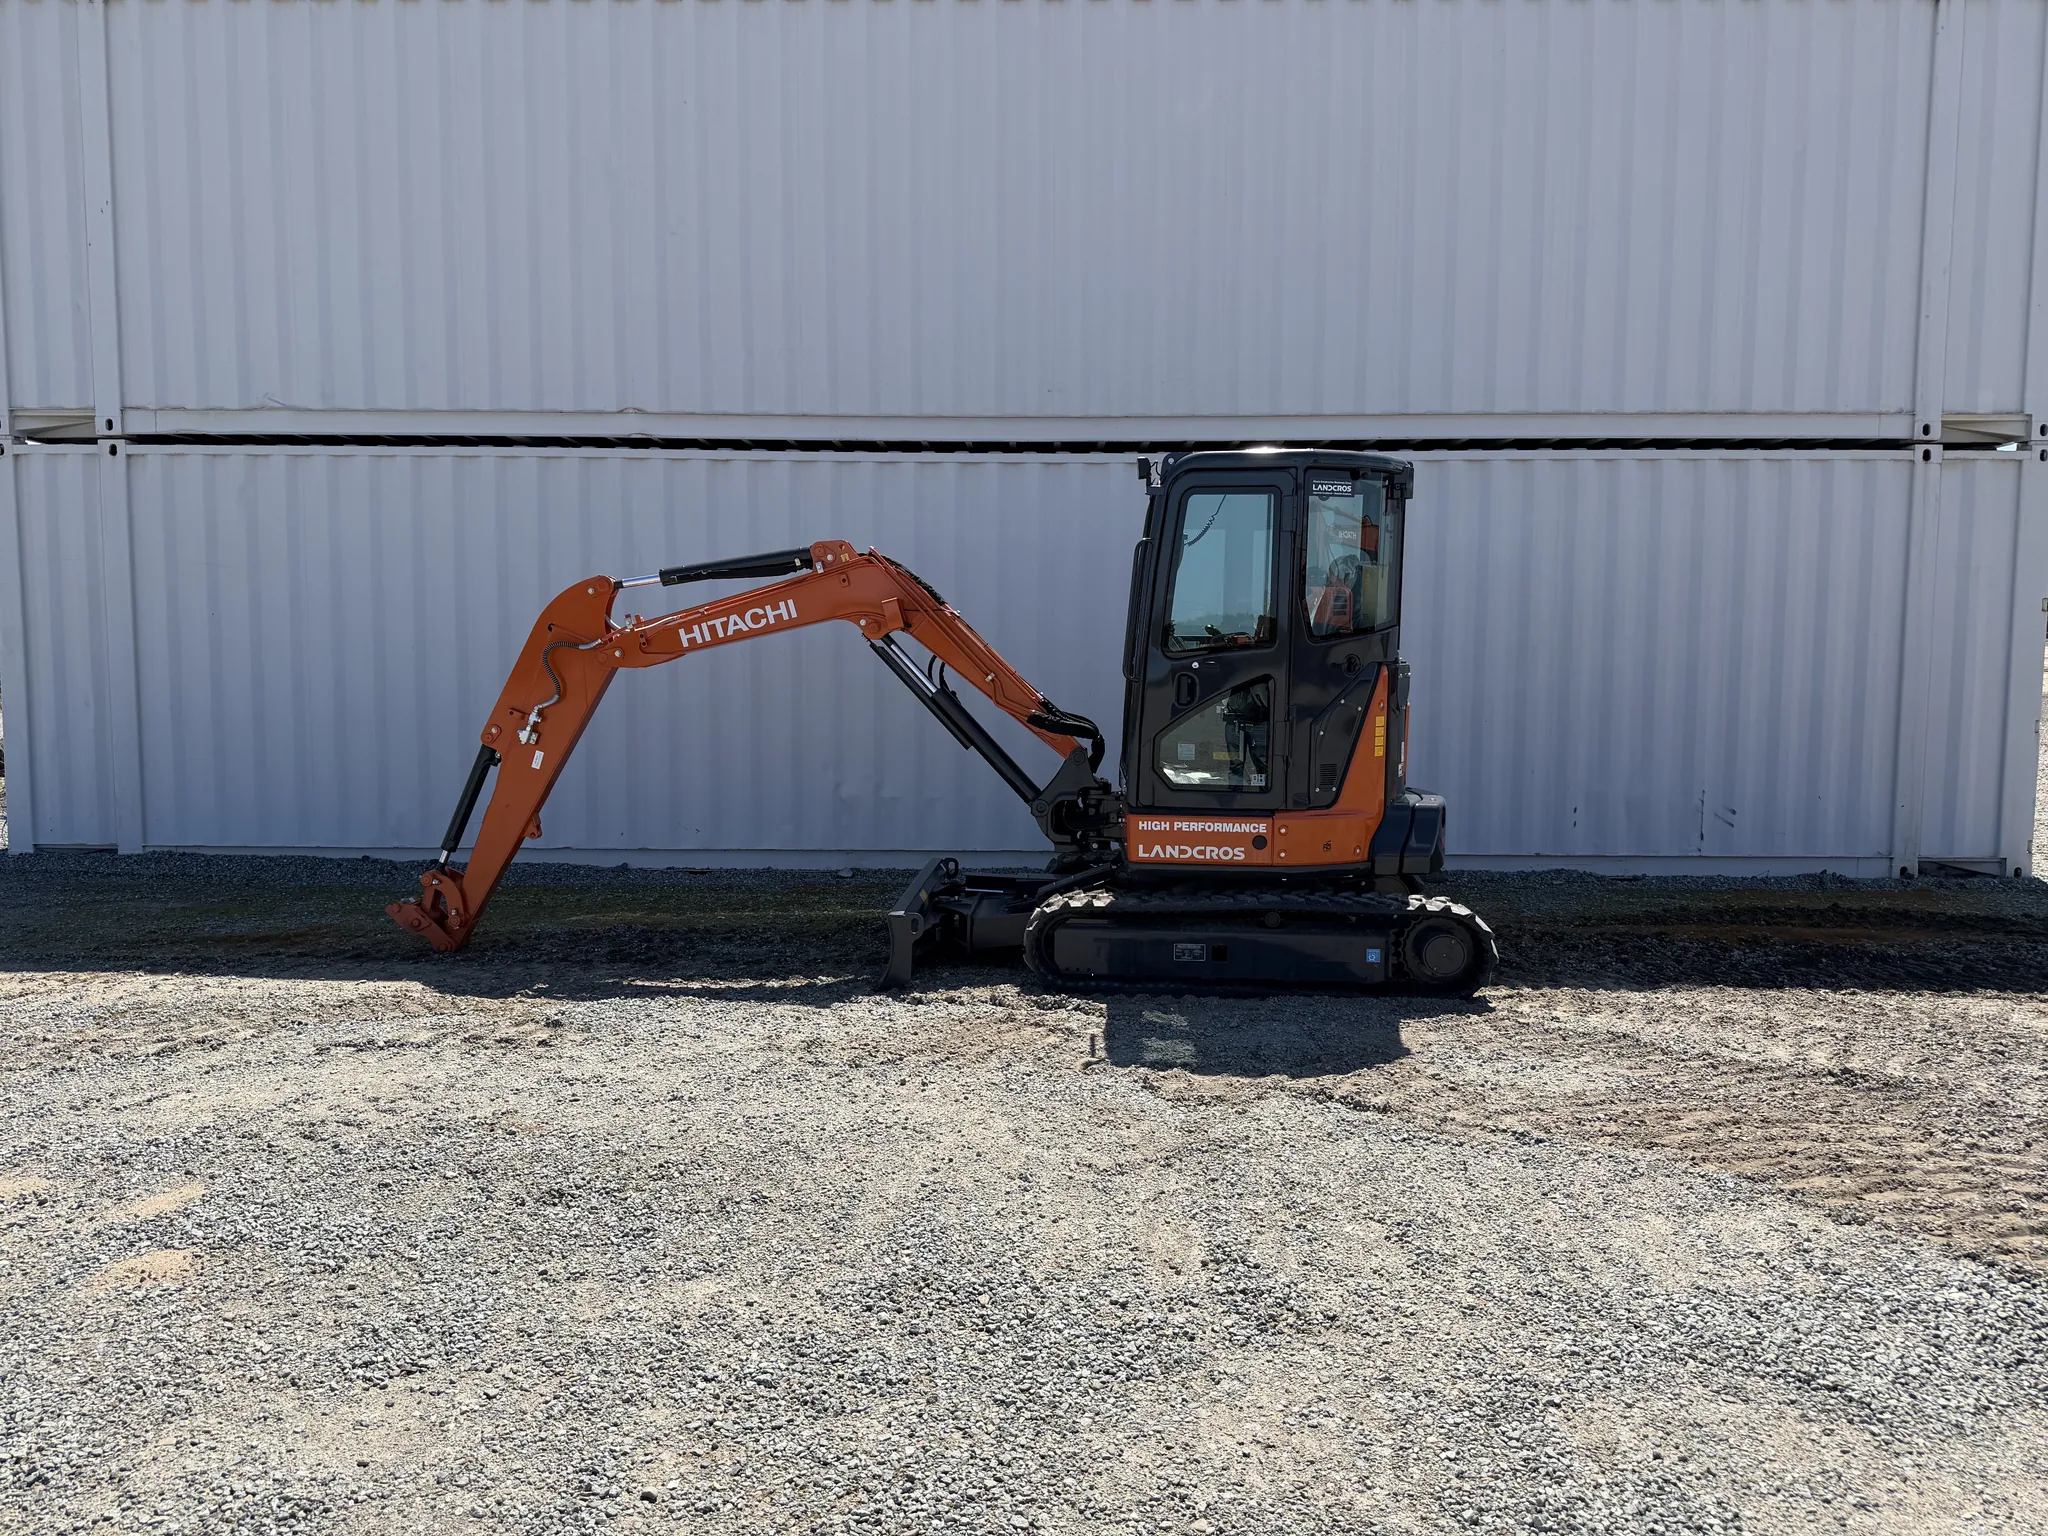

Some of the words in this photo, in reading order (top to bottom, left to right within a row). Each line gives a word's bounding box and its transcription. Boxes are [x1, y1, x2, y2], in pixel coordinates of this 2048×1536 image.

[1312, 484, 1352, 492] LANDCROS
[678, 599, 798, 648] HITACHI
[1138, 820, 1170, 831] HIGH
[1173, 821, 1267, 833] PERFORMANCE
[1138, 844, 1246, 861] LANDCROS
